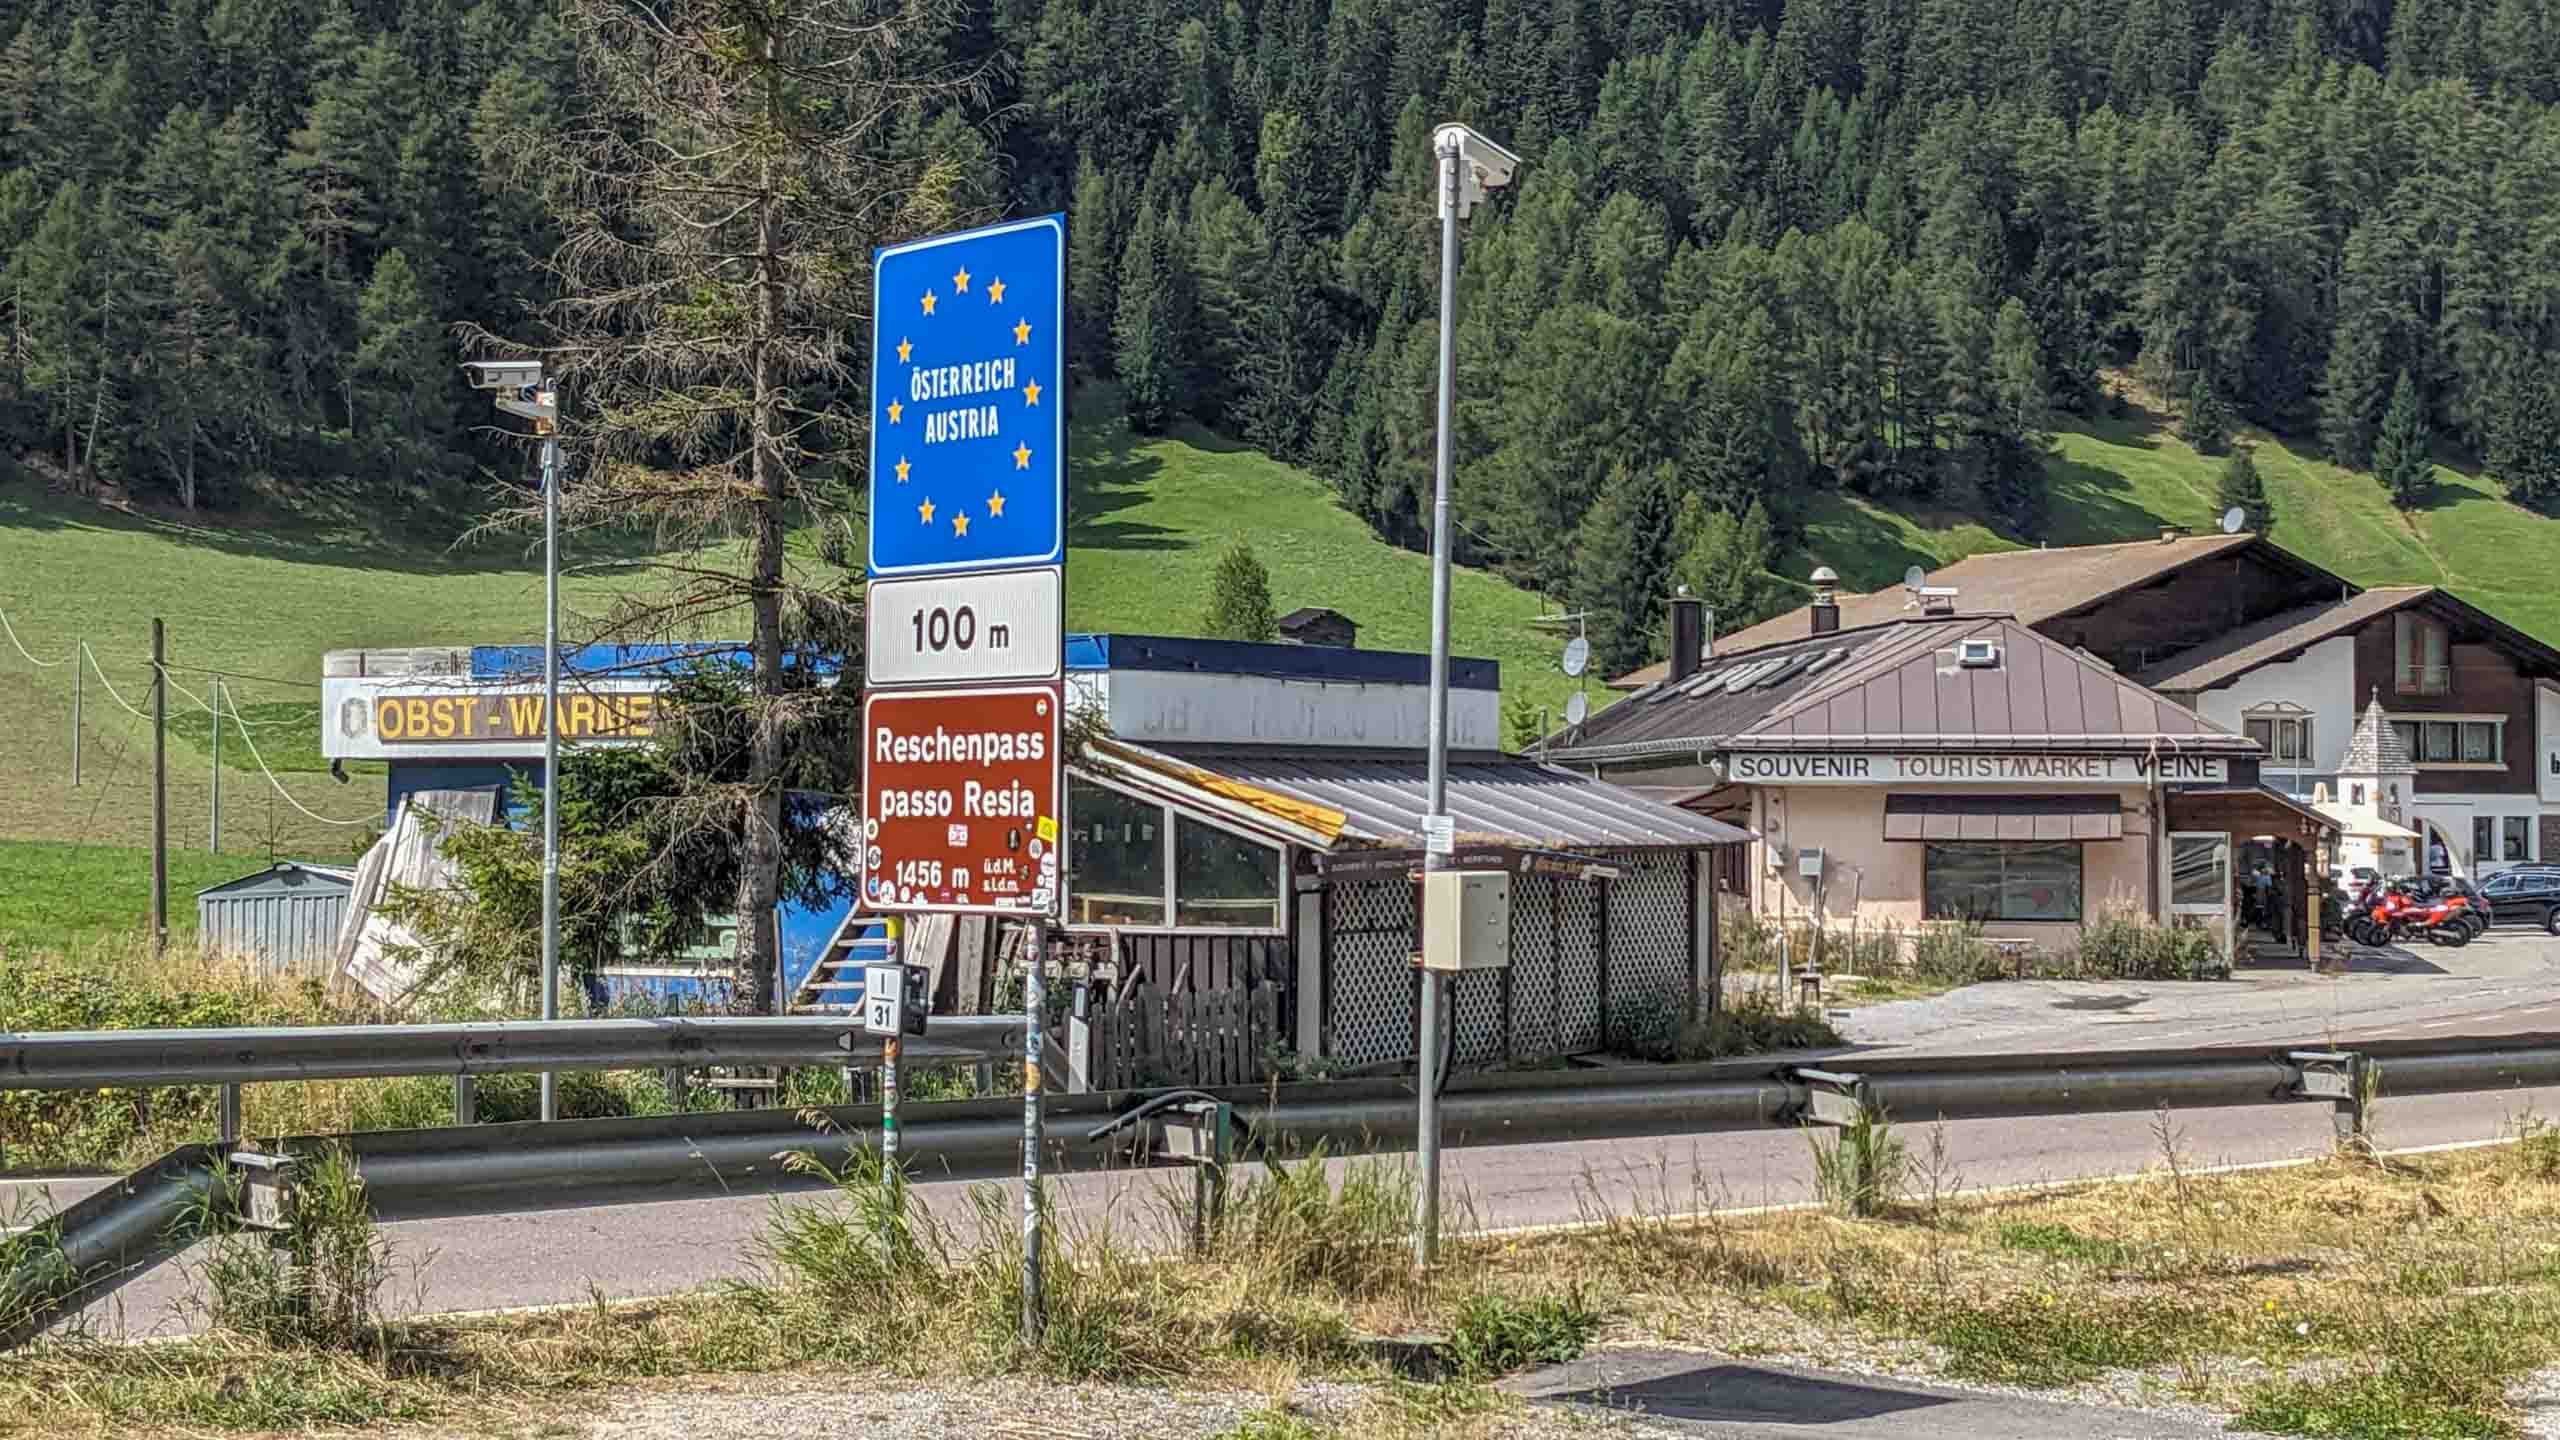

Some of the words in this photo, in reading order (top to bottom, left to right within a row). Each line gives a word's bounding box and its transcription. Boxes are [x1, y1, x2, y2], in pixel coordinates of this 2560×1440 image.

[911, 359, 1015, 401] ÖSTERREICH
[925, 405, 999, 444] AUSTRIA
[912, 605, 976, 653] 100
[989, 621, 1010, 649] m
[378, 697, 480, 738] OBST
[875, 726, 1045, 767] Reschenpass
[1739, 756, 1870, 778] SOUVENIR
[880, 787, 952, 822] passo
[964, 779, 1035, 817] Resia
[895, 859, 943, 889] 1456
[952, 867, 970, 889] m
[874, 1005, 890, 1027] 31
